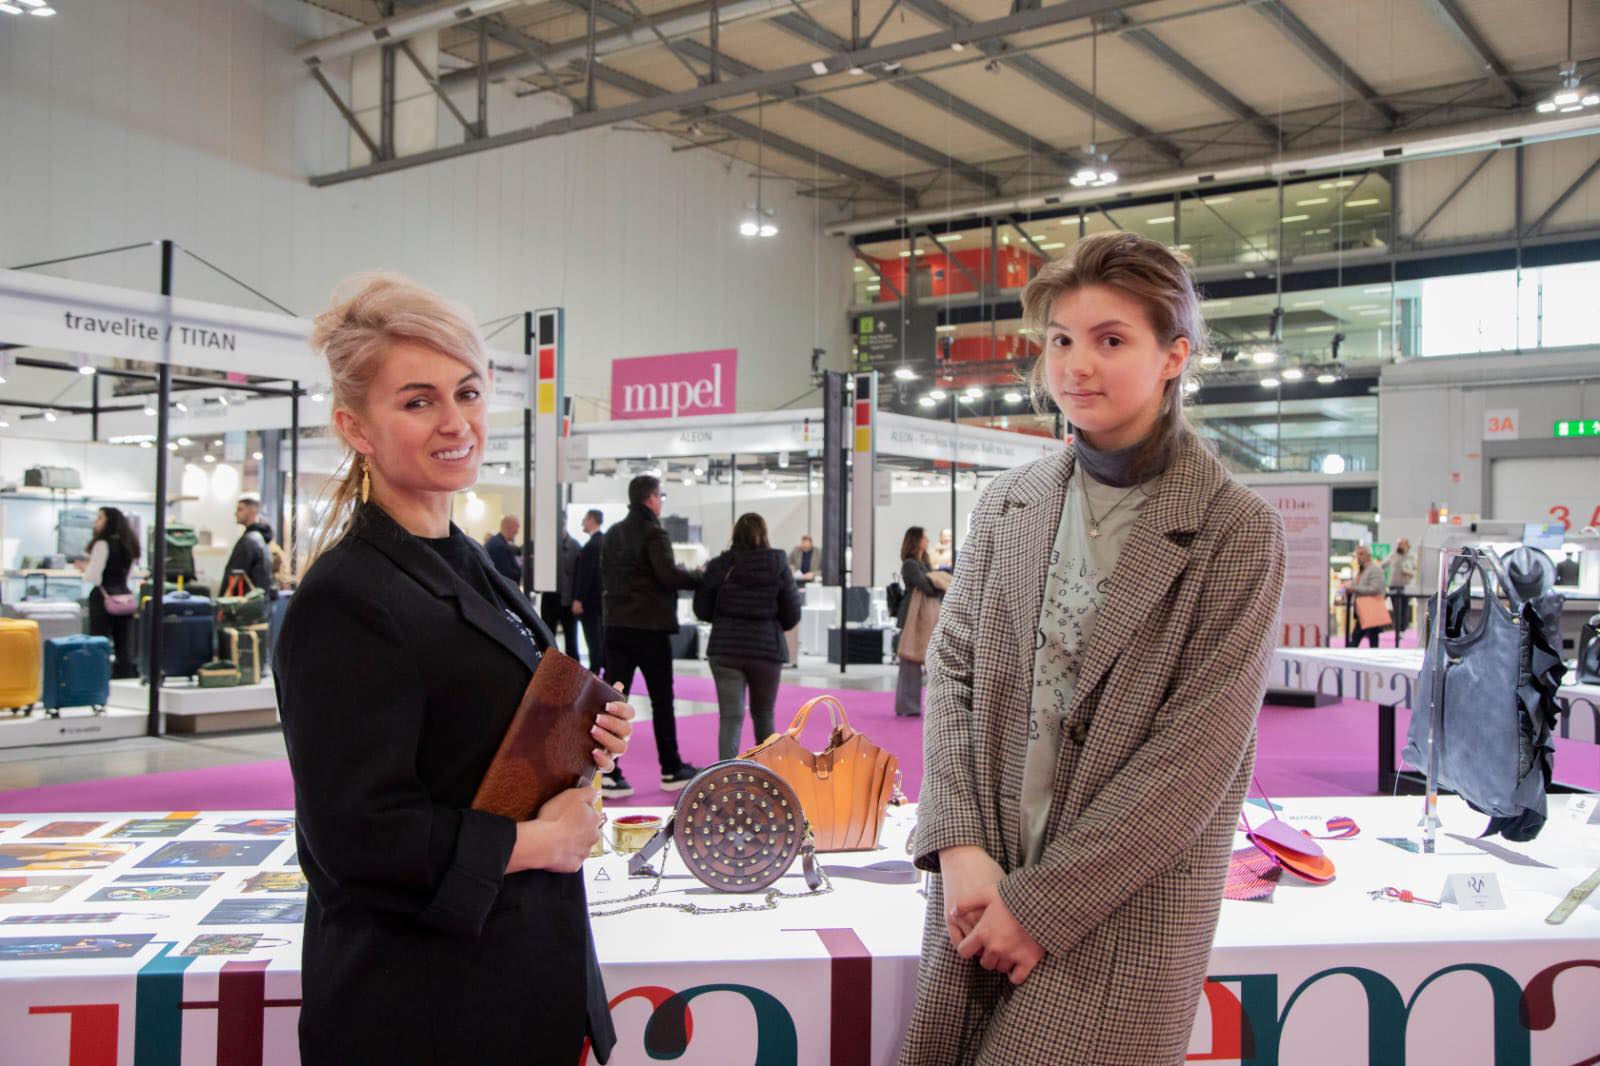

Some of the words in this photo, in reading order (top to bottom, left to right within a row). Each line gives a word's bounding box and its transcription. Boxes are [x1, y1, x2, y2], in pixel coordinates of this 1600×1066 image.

[65, 311, 159, 341] travelite
[180, 326, 236, 352] TITAN
[623, 363, 722, 417] mipel
[680, 431, 712, 443] ALEON
[1488, 416, 1514, 433] 3A
